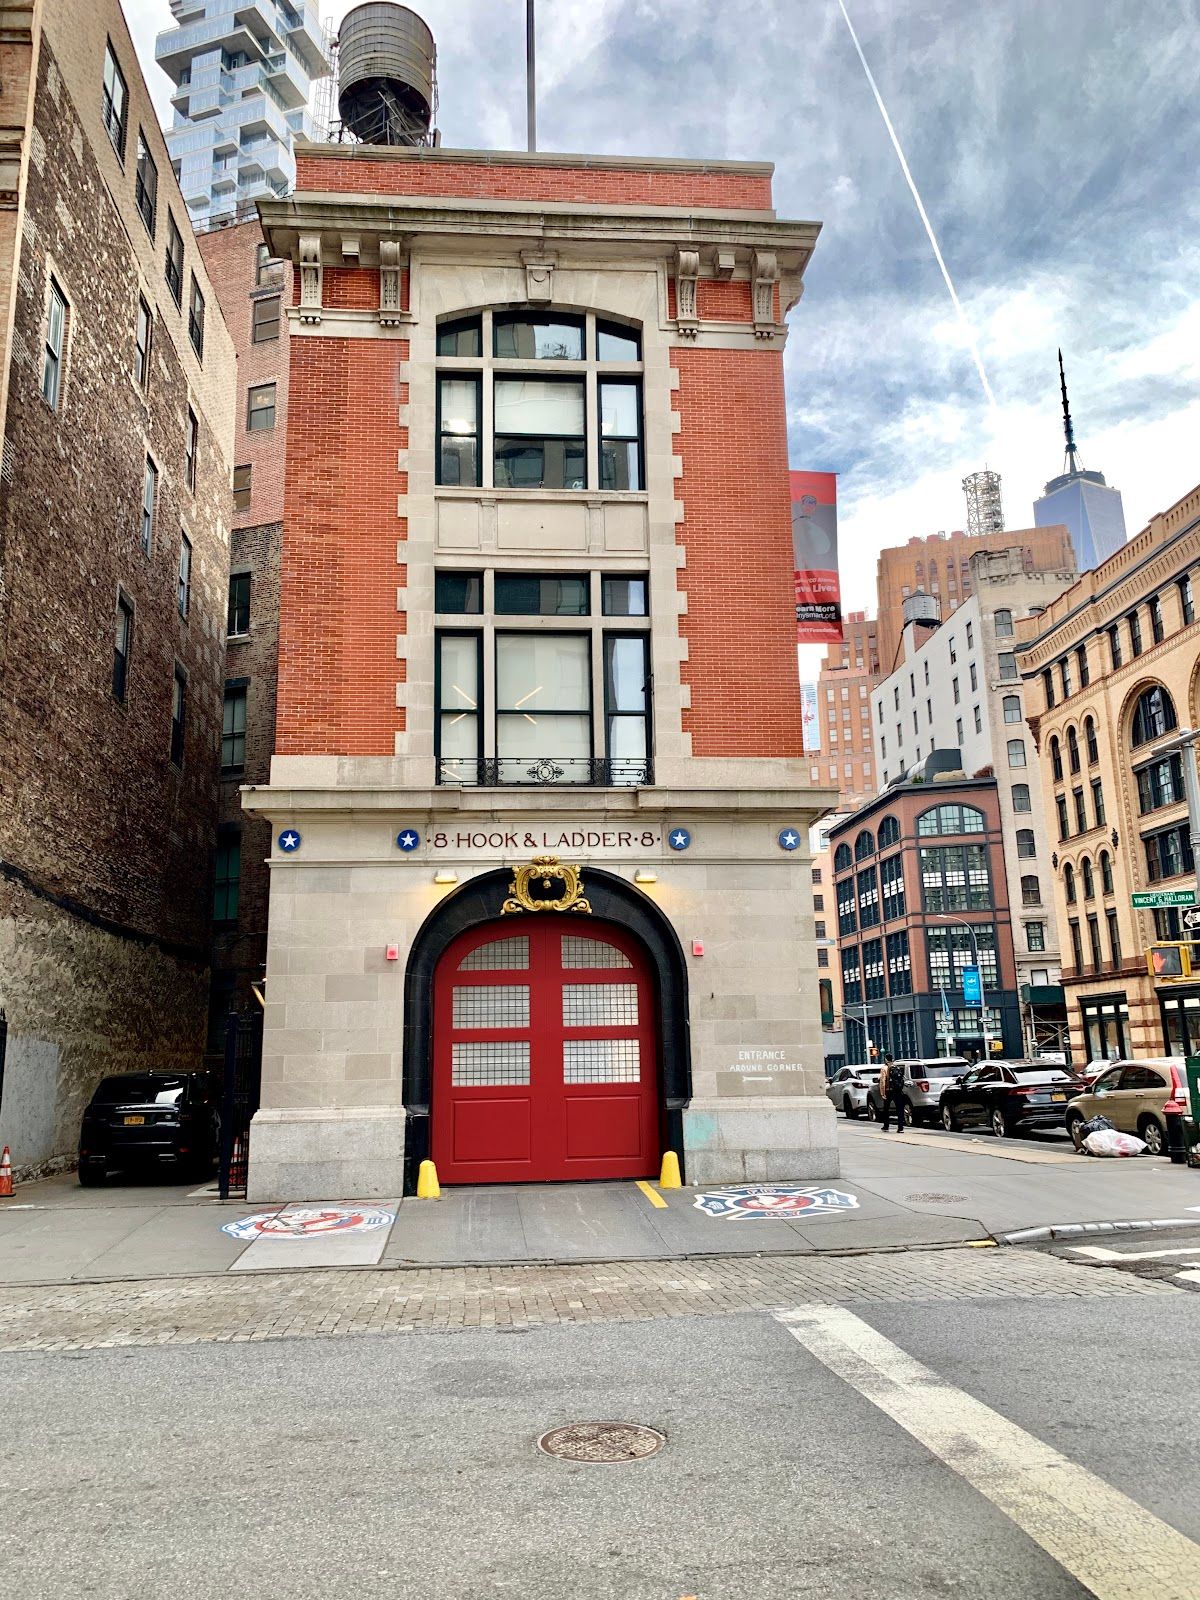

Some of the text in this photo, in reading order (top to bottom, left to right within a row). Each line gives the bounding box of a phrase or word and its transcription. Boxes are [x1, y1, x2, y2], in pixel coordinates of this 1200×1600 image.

[812, 584, 837, 592] Lives
[457, 832, 519, 848] HOOK
[523, 832, 538, 848] &
[543, 832, 633, 848] LADDER
[1134, 896, 1156, 904] VINCENT
[1164, 894, 1194, 902] HALLORAN
[738, 1050, 786, 1060] ENTRANCE
[729, 1063, 804, 1073] AROUND CORNER
